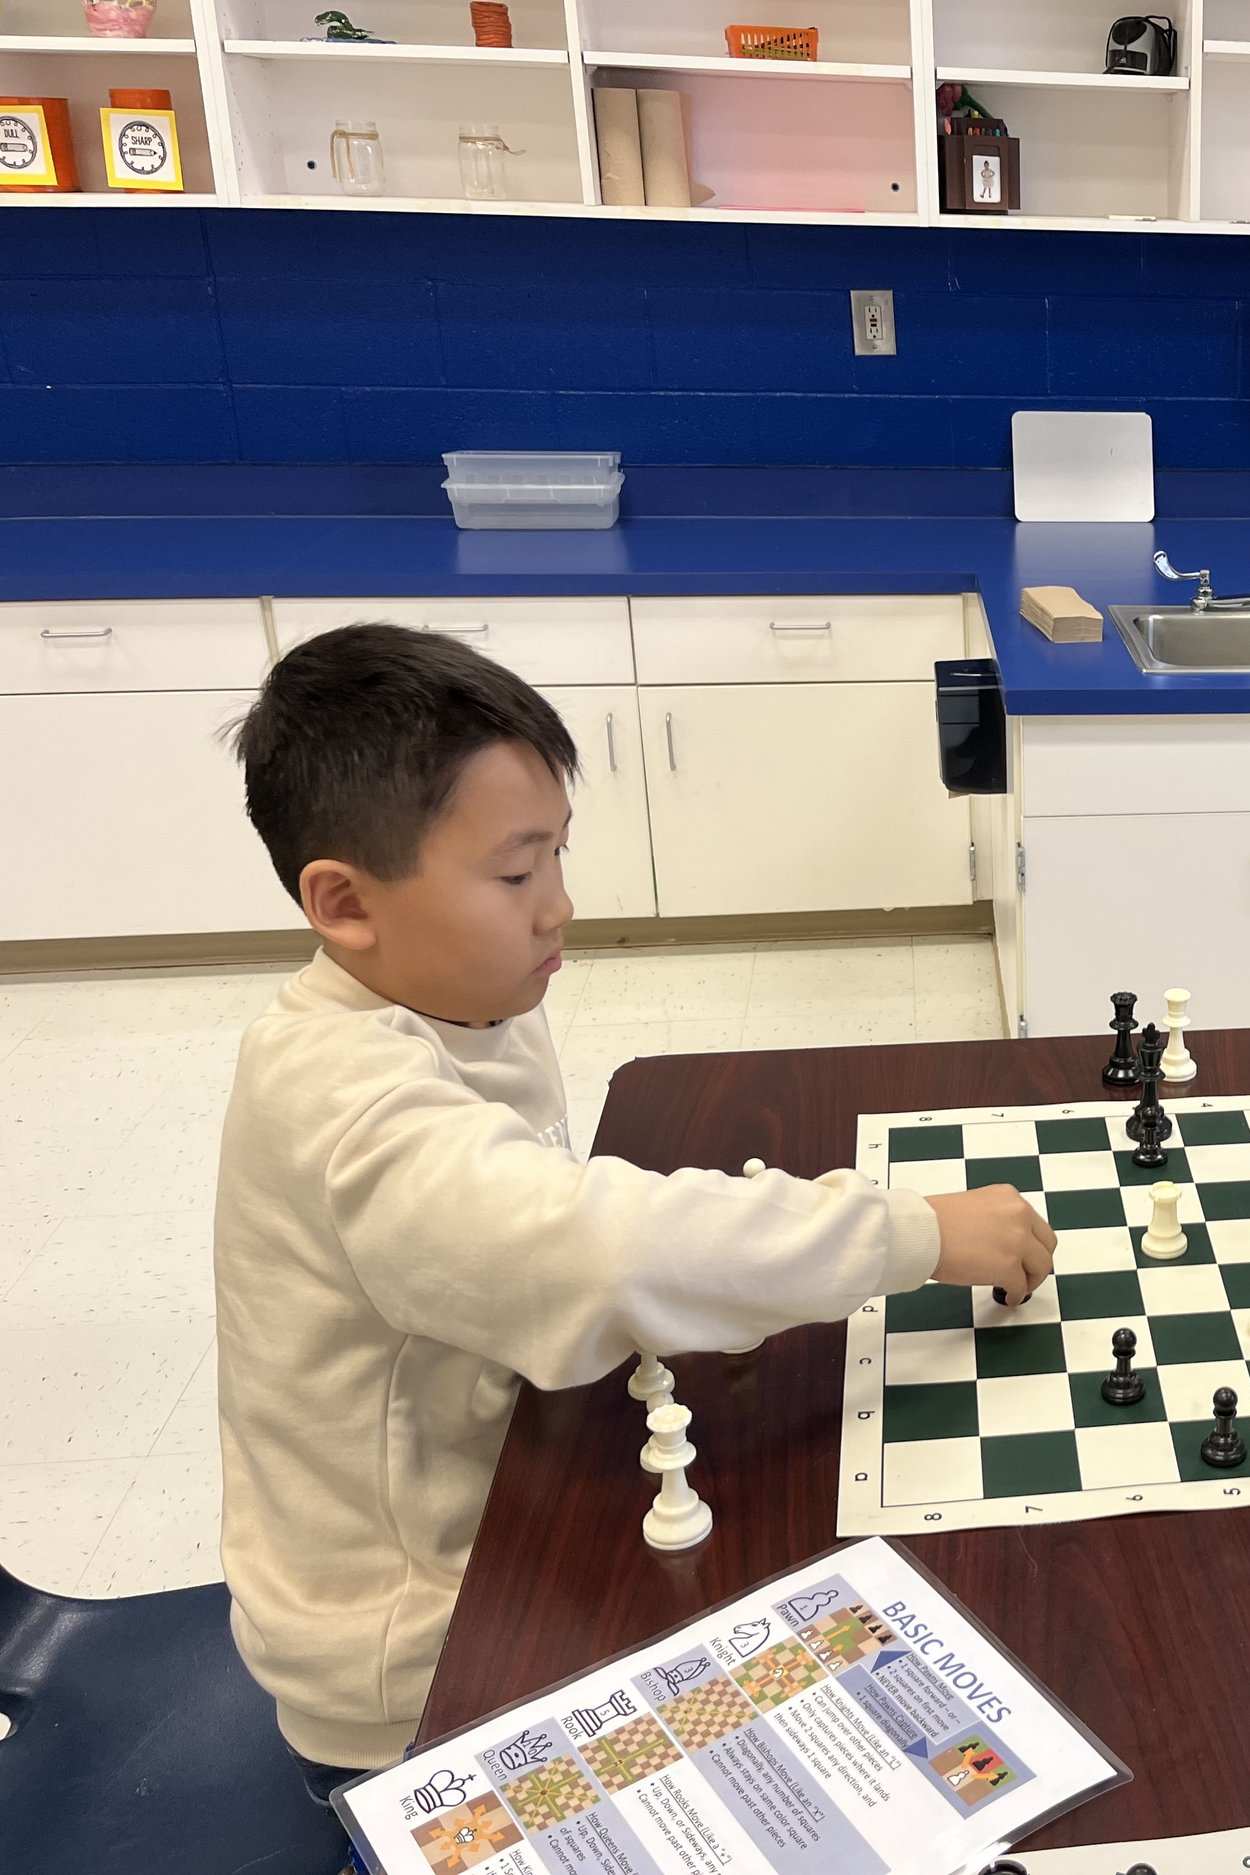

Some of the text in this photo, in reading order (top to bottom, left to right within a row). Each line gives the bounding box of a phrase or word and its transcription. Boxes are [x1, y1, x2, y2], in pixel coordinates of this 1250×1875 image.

[4, 128, 19, 139] DULL
[131, 135, 152, 146] SHARP
[862, 1305, 878, 1313] d
[857, 1411, 875, 1420] b
[855, 1472, 868, 1482] a
[1223, 1487, 1241, 1496] 5
[924, 1512, 942, 1521] 8
[1025, 1505, 1043, 1514] 7
[775, 1603, 801, 1627] Pawn
[705, 1637, 738, 1666] Knight
[881, 1600, 1013, 1724] BASIC MOVES
[637, 1671, 668, 1703] Bishop
[908, 1653, 954, 1699] How Pawns Move
[877, 1675, 938, 1737] NEVER move backward
[891, 1674, 915, 1696] squares
[913, 1695, 922, 1703] on
[920, 1702, 934, 1714] first
[931, 1714, 948, 1731] move
[903, 1667, 924, 1687] square
[922, 1685, 946, 1708] forward
[946, 1712, 956, 1720] or
[560, 1715, 584, 1740] Rook
[821, 1684, 837, 1698] How
[831, 1697, 856, 1719] Knights
[851, 1717, 871, 1735] Move
[864, 1734, 883, 1750] (Like
[878, 1748, 889, 1757] an
[860, 1700, 882, 1720] square
[877, 1718, 909, 1748] diagonally
[866, 1684, 918, 1739] How Pawns Capture
[773, 1712, 789, 1727] then
[783, 1726, 811, 1754] sideways
[809, 1757, 831, 1779] square
[813, 1695, 884, 1772] Can jump over other pieces
[481, 1748, 510, 1781] Queen
[744, 1728, 760, 1743] How
[754, 1742, 779, 1766] Bishops
[775, 1764, 794, 1783] Move
[787, 1782, 806, 1799] (Like
[801, 1798, 812, 1807] an
[789, 1710, 808, 1727] Move
[806, 1732, 830, 1756] squares
[825, 1754, 839, 1767] any
[836, 1765, 866, 1795] direction,
[861, 1793, 877, 1807] and
[800, 1702, 817, 1717] Only
[812, 1716, 839, 1742] captures
[833, 1740, 855, 1761] pieces
[851, 1759, 872, 1779] where
[872, 1783, 891, 1801] lands
[395, 1794, 421, 1820] King
[649, 1786, 664, 1800] Up,
[710, 1754, 788, 1848] Cannot move past other pieces
[721, 1746, 807, 1850] Always stays on same color square
[734, 1739, 820, 1842] Diagonally, any number of squares
[659, 1798, 680, 1820] Down,
[661, 1774, 676, 1790] How
[672, 1789, 691, 1809] Rooks
[686, 1808, 705, 1828] Move
[698, 1827, 717, 1845] (Like
[675, 1819, 684, 1828] or
[559, 1826, 571, 1836] of
[574, 1824, 606, 1860] Up, Down,
[587, 1812, 603, 1828] How
[598, 1827, 621, 1853] Queens
[616, 1852, 635, 1873] Move
[637, 1793, 659, 1816] Cannot
[654, 1817, 671, 1835] move
[665, 1834, 684, 1851] past
[678, 1848, 698, 1869] other
[679, 1827, 709, 1861] Sideways,
[548, 1838, 570, 1864] Cannot
[562, 1835, 586, 1862] squares
[703, 1860, 718, 1874] any
